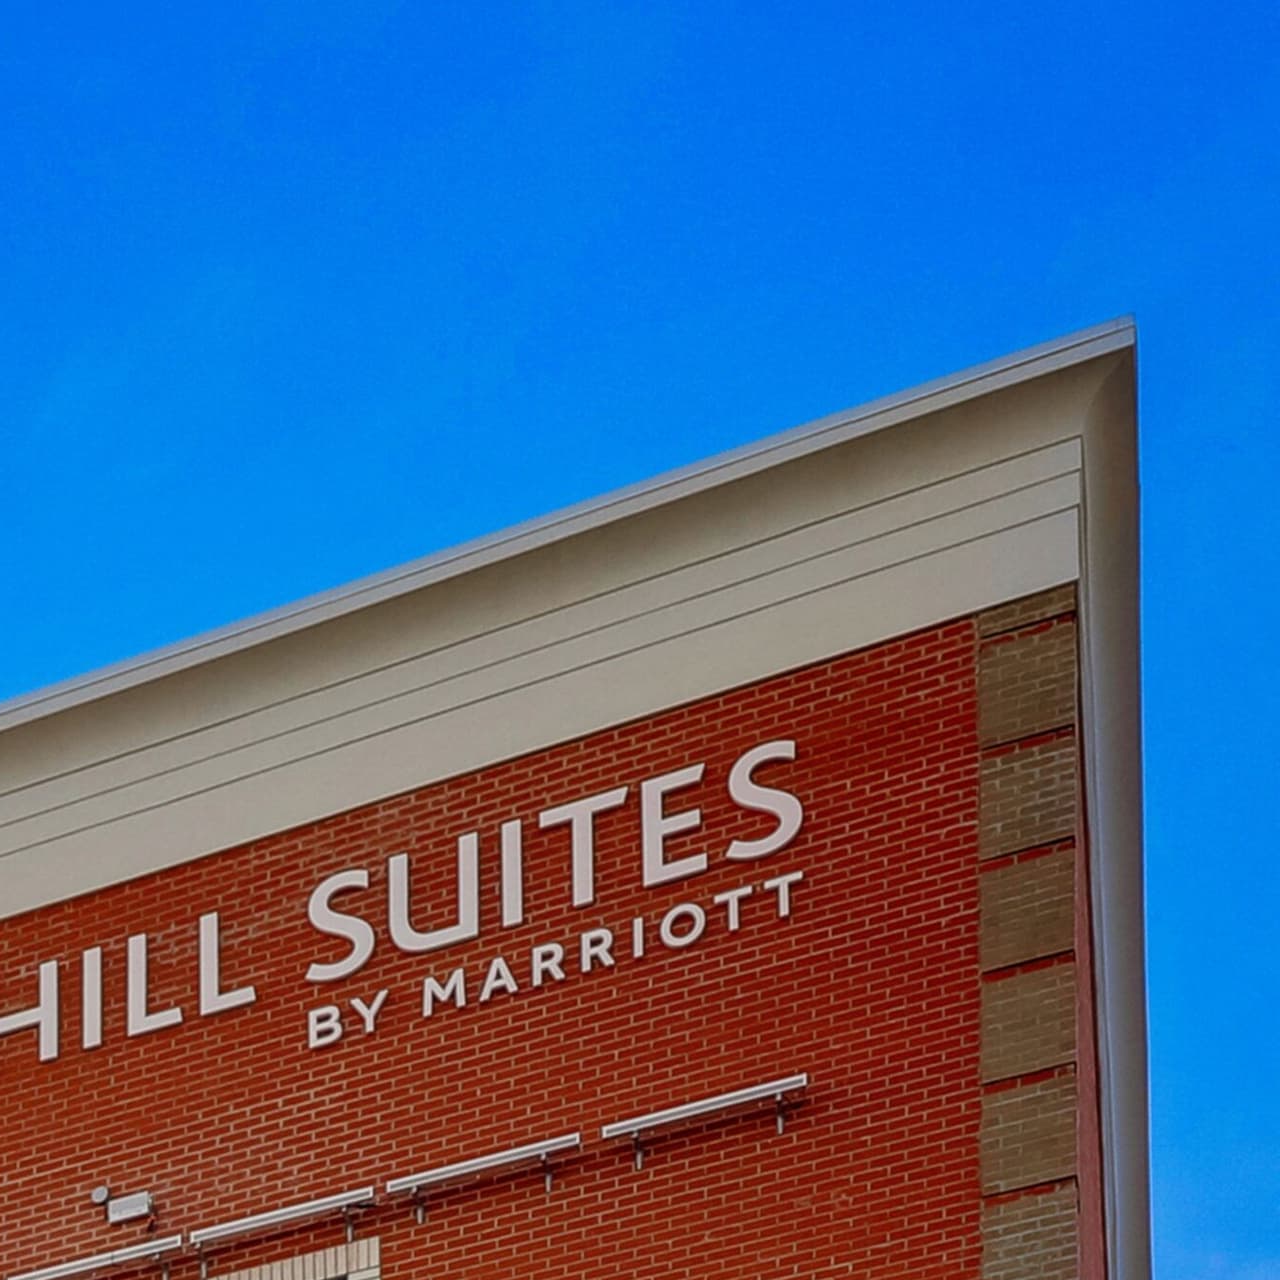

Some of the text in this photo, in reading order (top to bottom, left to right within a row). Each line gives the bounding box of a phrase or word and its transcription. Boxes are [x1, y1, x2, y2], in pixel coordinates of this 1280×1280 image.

[305, 739, 804, 982] SUITES
[307, 870, 804, 1049] BY MARRIOTT
